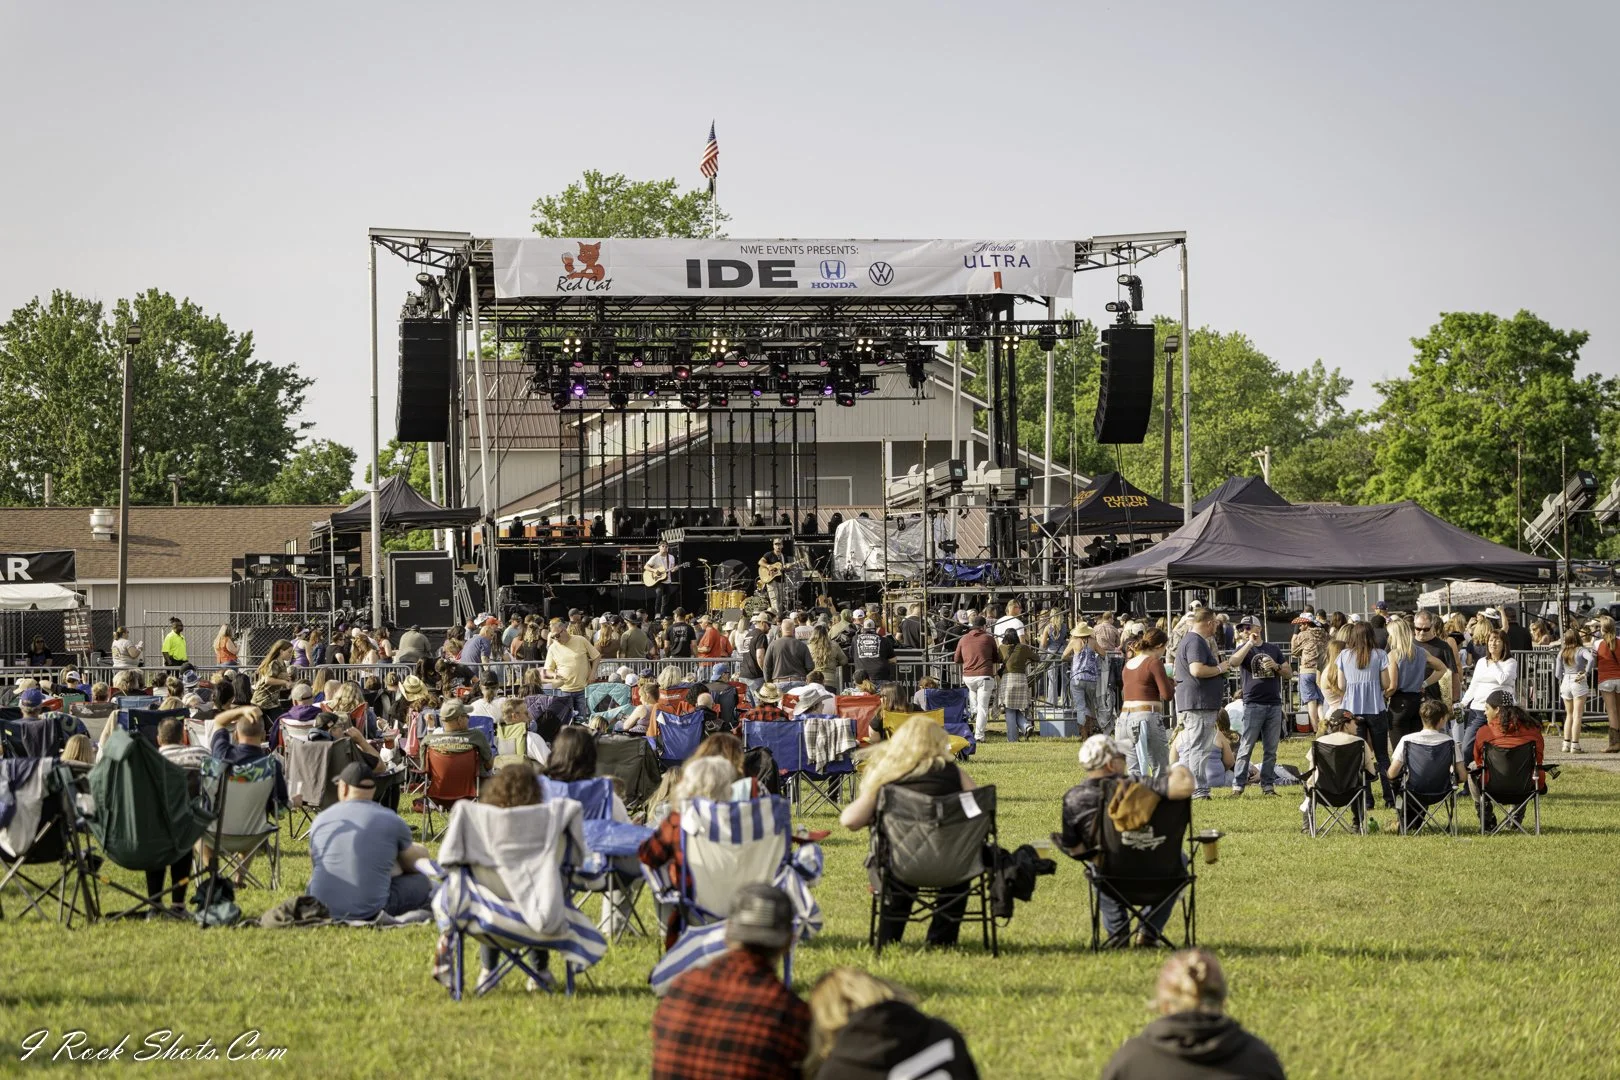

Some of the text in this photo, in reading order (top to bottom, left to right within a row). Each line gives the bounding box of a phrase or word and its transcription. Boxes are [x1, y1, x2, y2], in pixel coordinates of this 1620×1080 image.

[740, 245, 859, 255] NWE EVENTS PRESENTS:
[972, 242, 1016, 253] Michelob
[964, 254, 1031, 269] ULTRA
[686, 259, 798, 288] IDE
[556, 275, 614, 292] Red Cat
